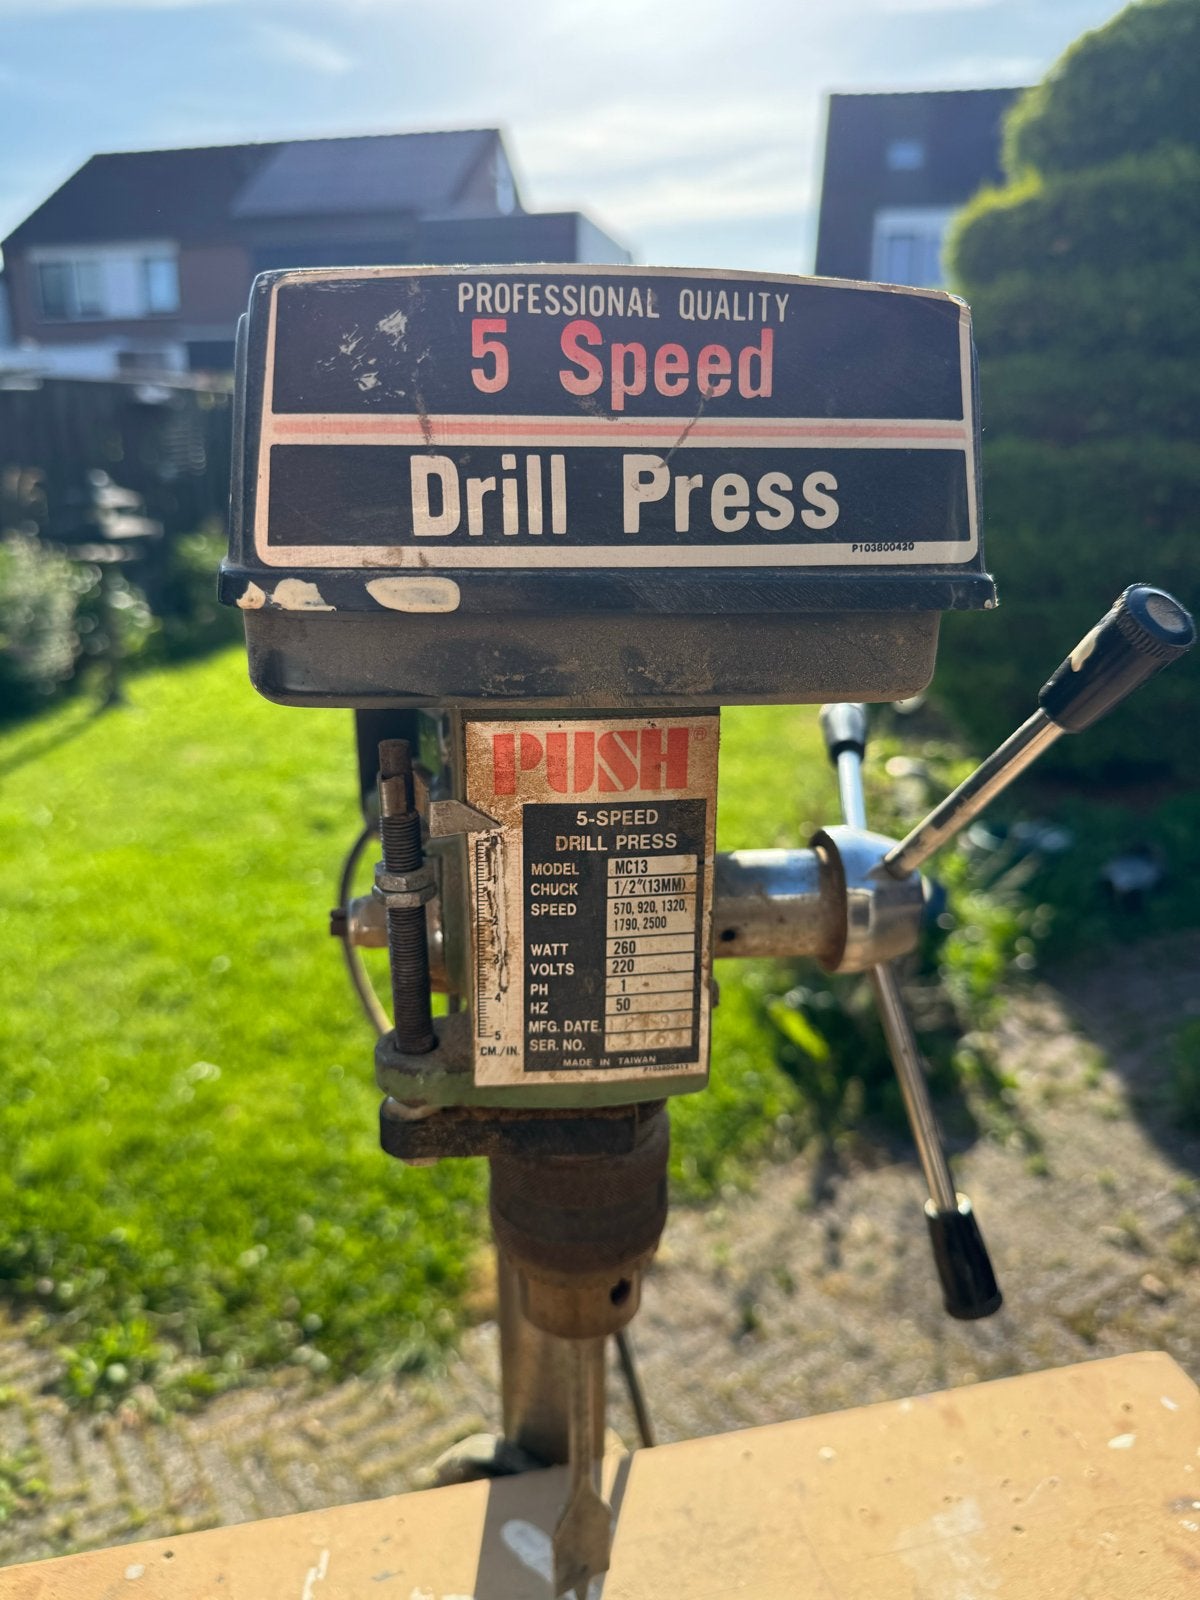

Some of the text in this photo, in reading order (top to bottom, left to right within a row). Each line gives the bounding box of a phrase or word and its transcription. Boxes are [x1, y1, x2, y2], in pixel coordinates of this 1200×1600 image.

[458, 282, 790, 323] PROFESSIONAL QUALITY
[471, 318, 774, 411] 5 Speed
[410, 453, 841, 537] Drill Press
[852, 542, 915, 553] P103800420
[493, 727, 690, 796] PUSH
[576, 809, 659, 827] 5-SPEED
[555, 832, 678, 852] DRILL PRESS
[531, 859, 648, 876] MODEL MC13
[530, 882, 579, 896] CHUCK
[530, 898, 688, 917] SPEED 570, 920, 1320,
[614, 916, 667, 932] 1790, 2500
[530, 940, 636, 956] WATT 260
[530, 958, 635, 976] VOLTS 220
[530, 978, 626, 996] PH 1
[494, 992, 502, 1003] 4
[530, 997, 631, 1014] HZ 50
[528, 1020, 560, 1033] MFG.
[494, 1030, 502, 1041] 5
[529, 1038, 586, 1051] SER. NO.
[562, 1055, 657, 1067] MADE IN TAIWAN
